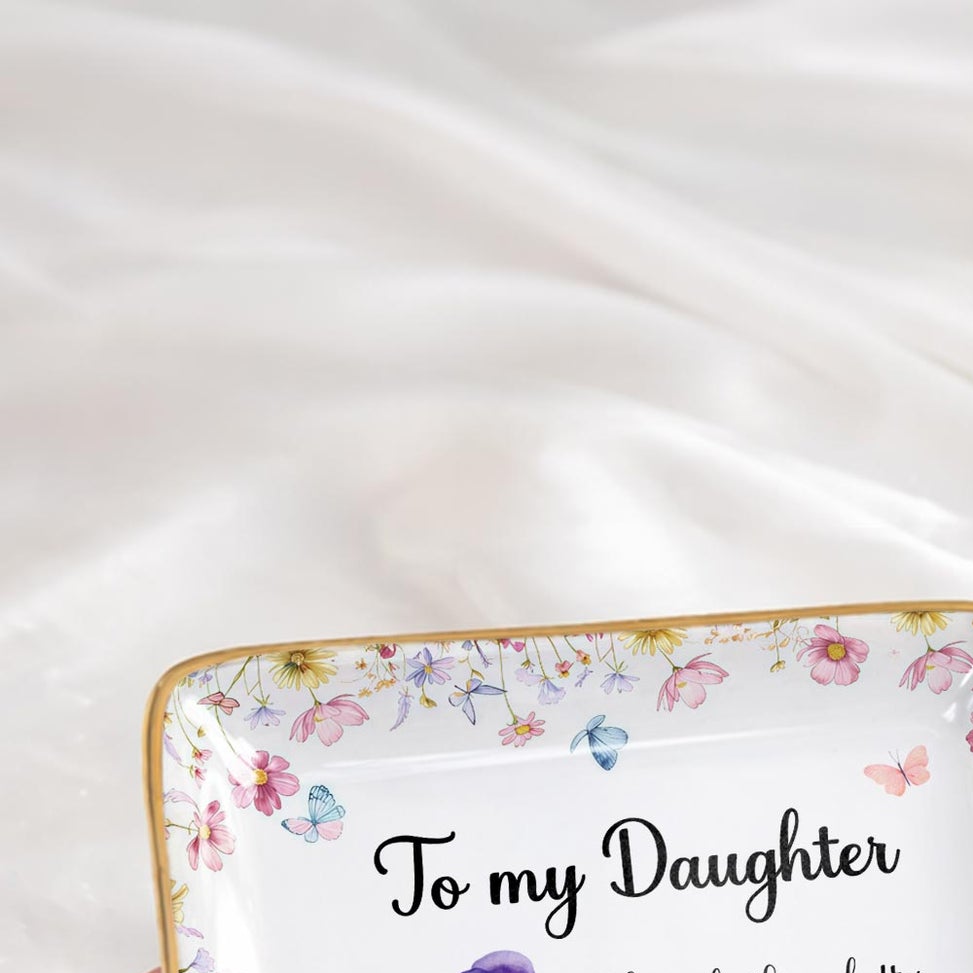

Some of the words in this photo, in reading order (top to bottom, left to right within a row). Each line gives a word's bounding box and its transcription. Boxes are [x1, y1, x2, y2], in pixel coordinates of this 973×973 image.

[373, 831, 470, 917] To
[489, 865, 586, 940] my
[601, 807, 901, 924] Daughter
